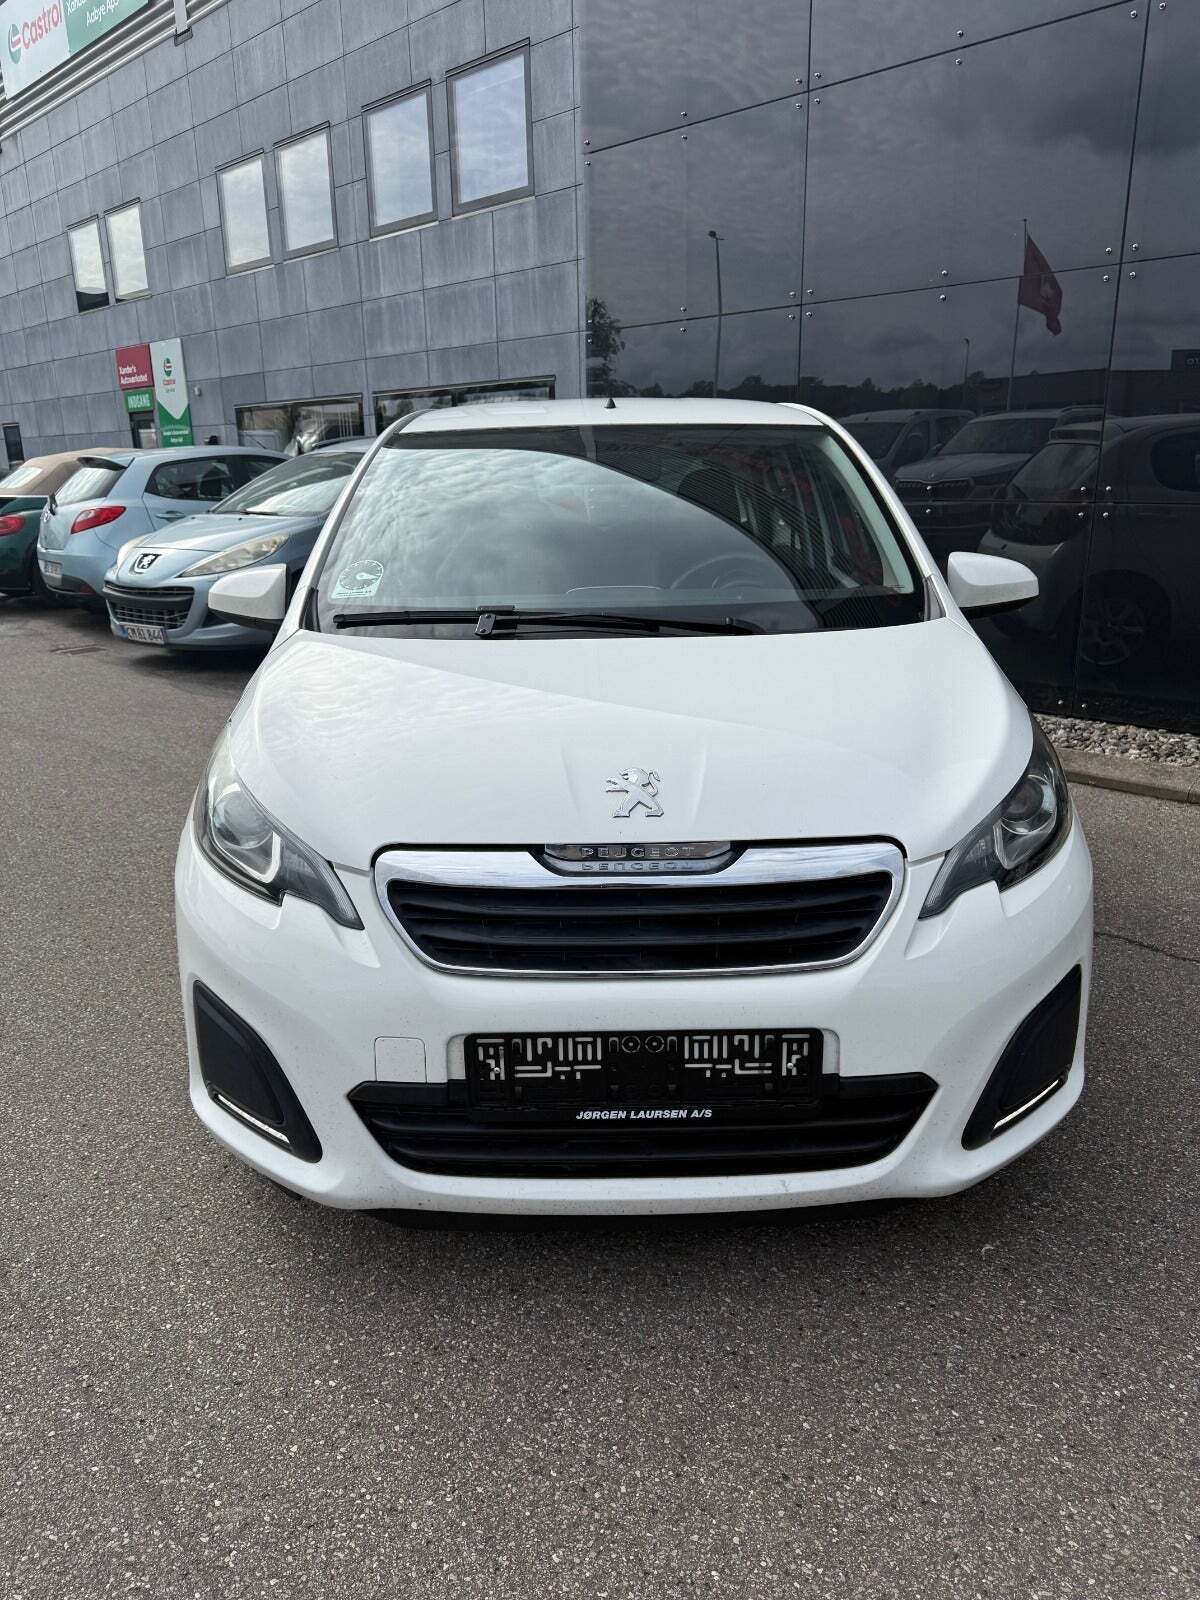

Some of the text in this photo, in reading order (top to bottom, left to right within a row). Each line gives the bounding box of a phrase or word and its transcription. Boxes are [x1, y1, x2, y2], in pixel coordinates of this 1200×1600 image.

[21, 1, 62, 49] Castrol
[581, 847, 695, 858] PEUGEOT
[576, 1109, 713, 1120] JØRGEN LAURSEN A/S
